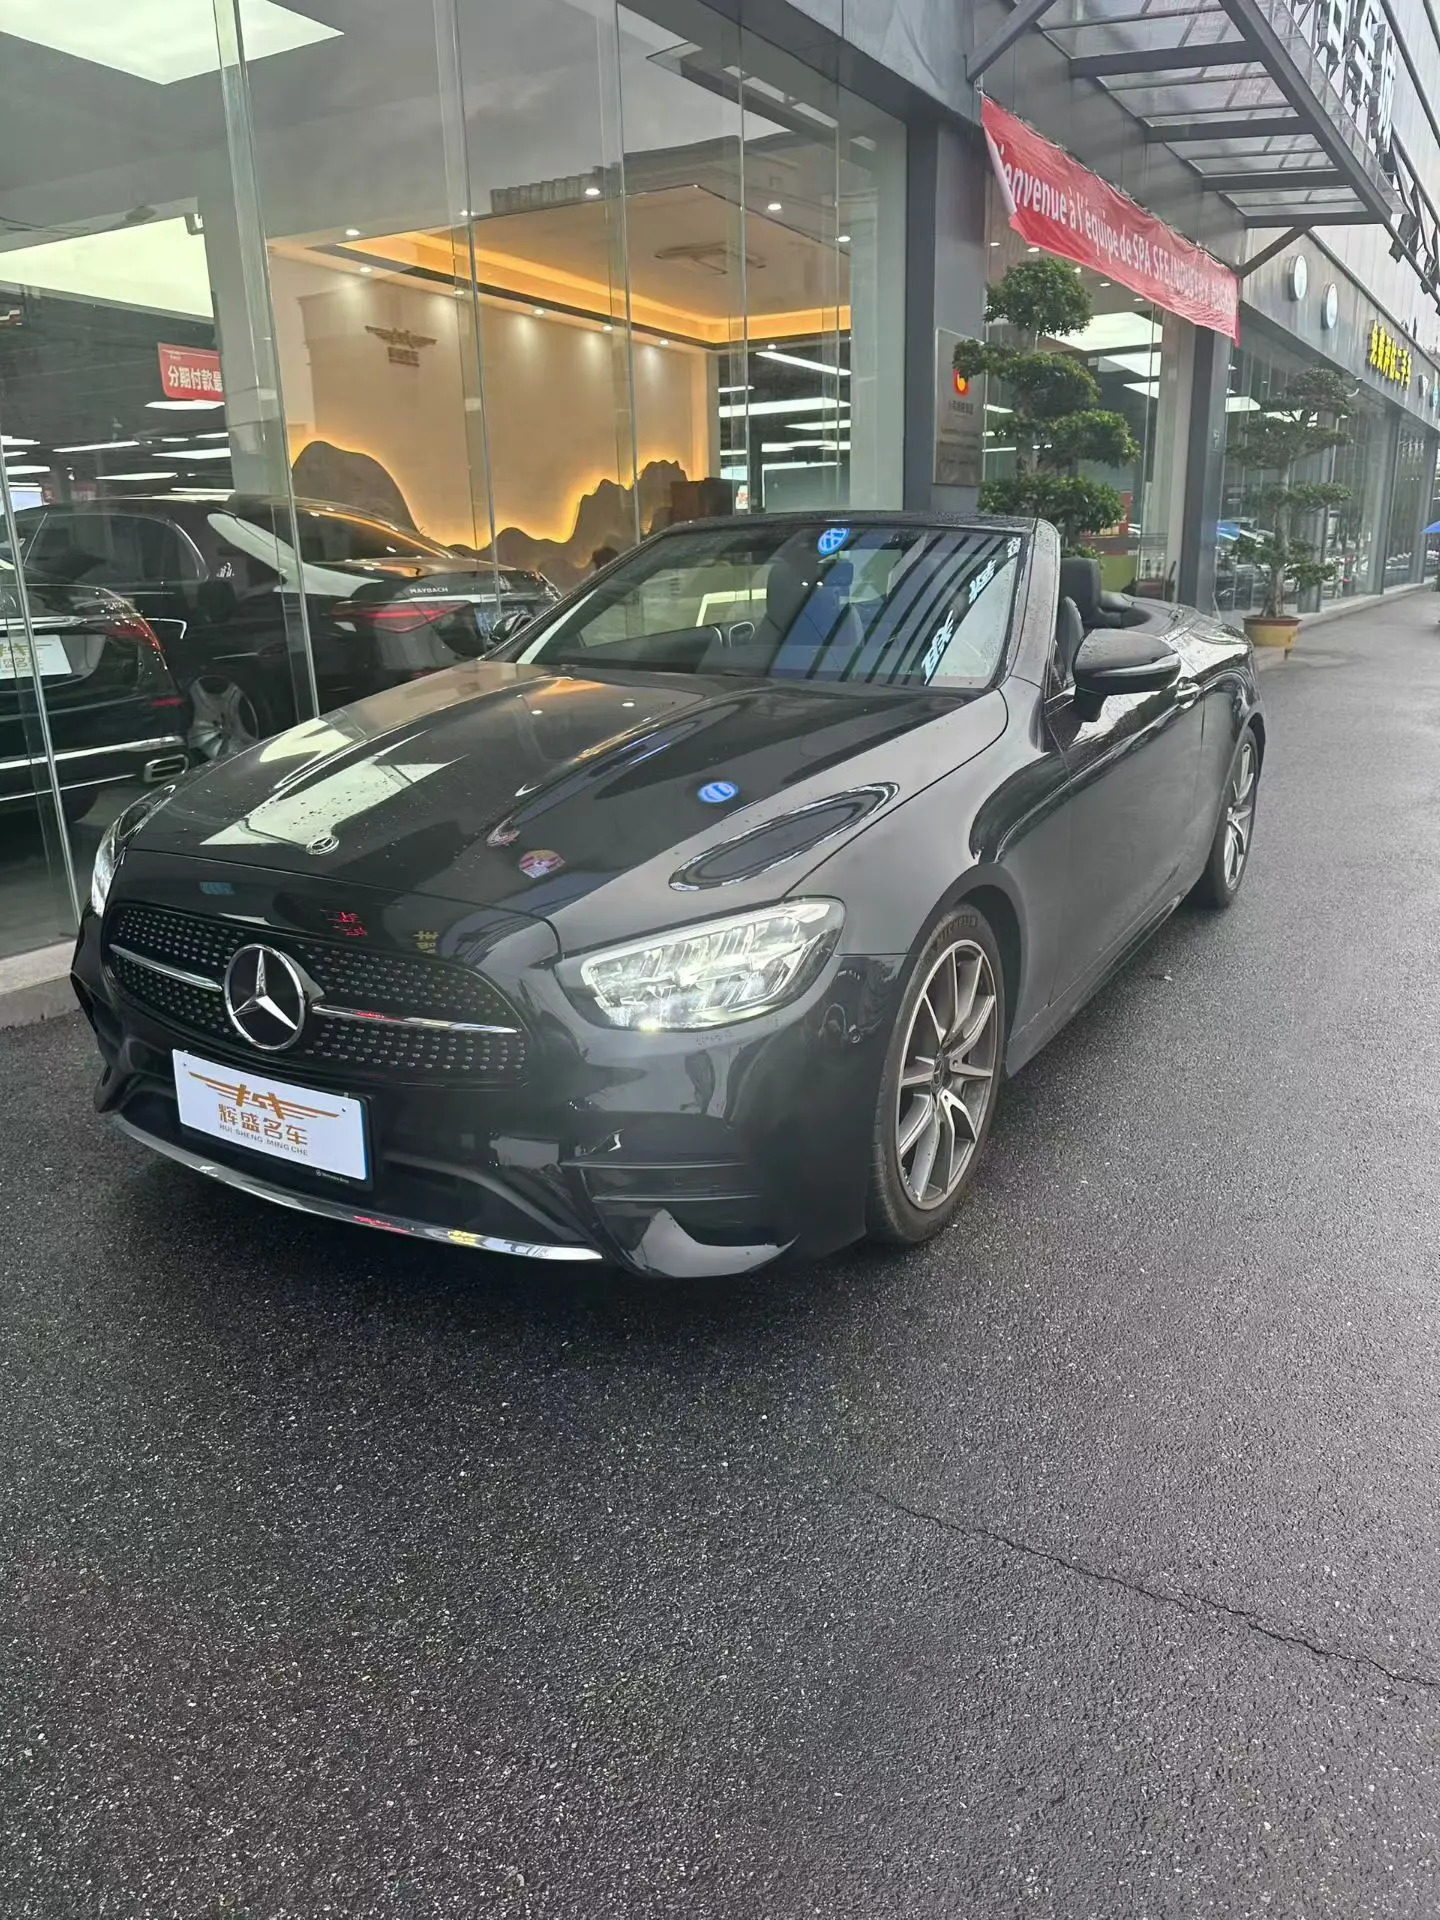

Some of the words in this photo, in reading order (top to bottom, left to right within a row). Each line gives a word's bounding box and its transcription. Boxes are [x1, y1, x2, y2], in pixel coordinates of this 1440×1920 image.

[1120, 224, 1131, 267] de
[1133, 233, 1152, 277] SPA
[219, 1104, 308, 1145] 辉盛名车
[219, 1124, 233, 1133] HUI
[235, 1128, 263, 1144] SHENG
[266, 1139, 290, 1151] MING
[291, 1145, 308, 1156] CHE
